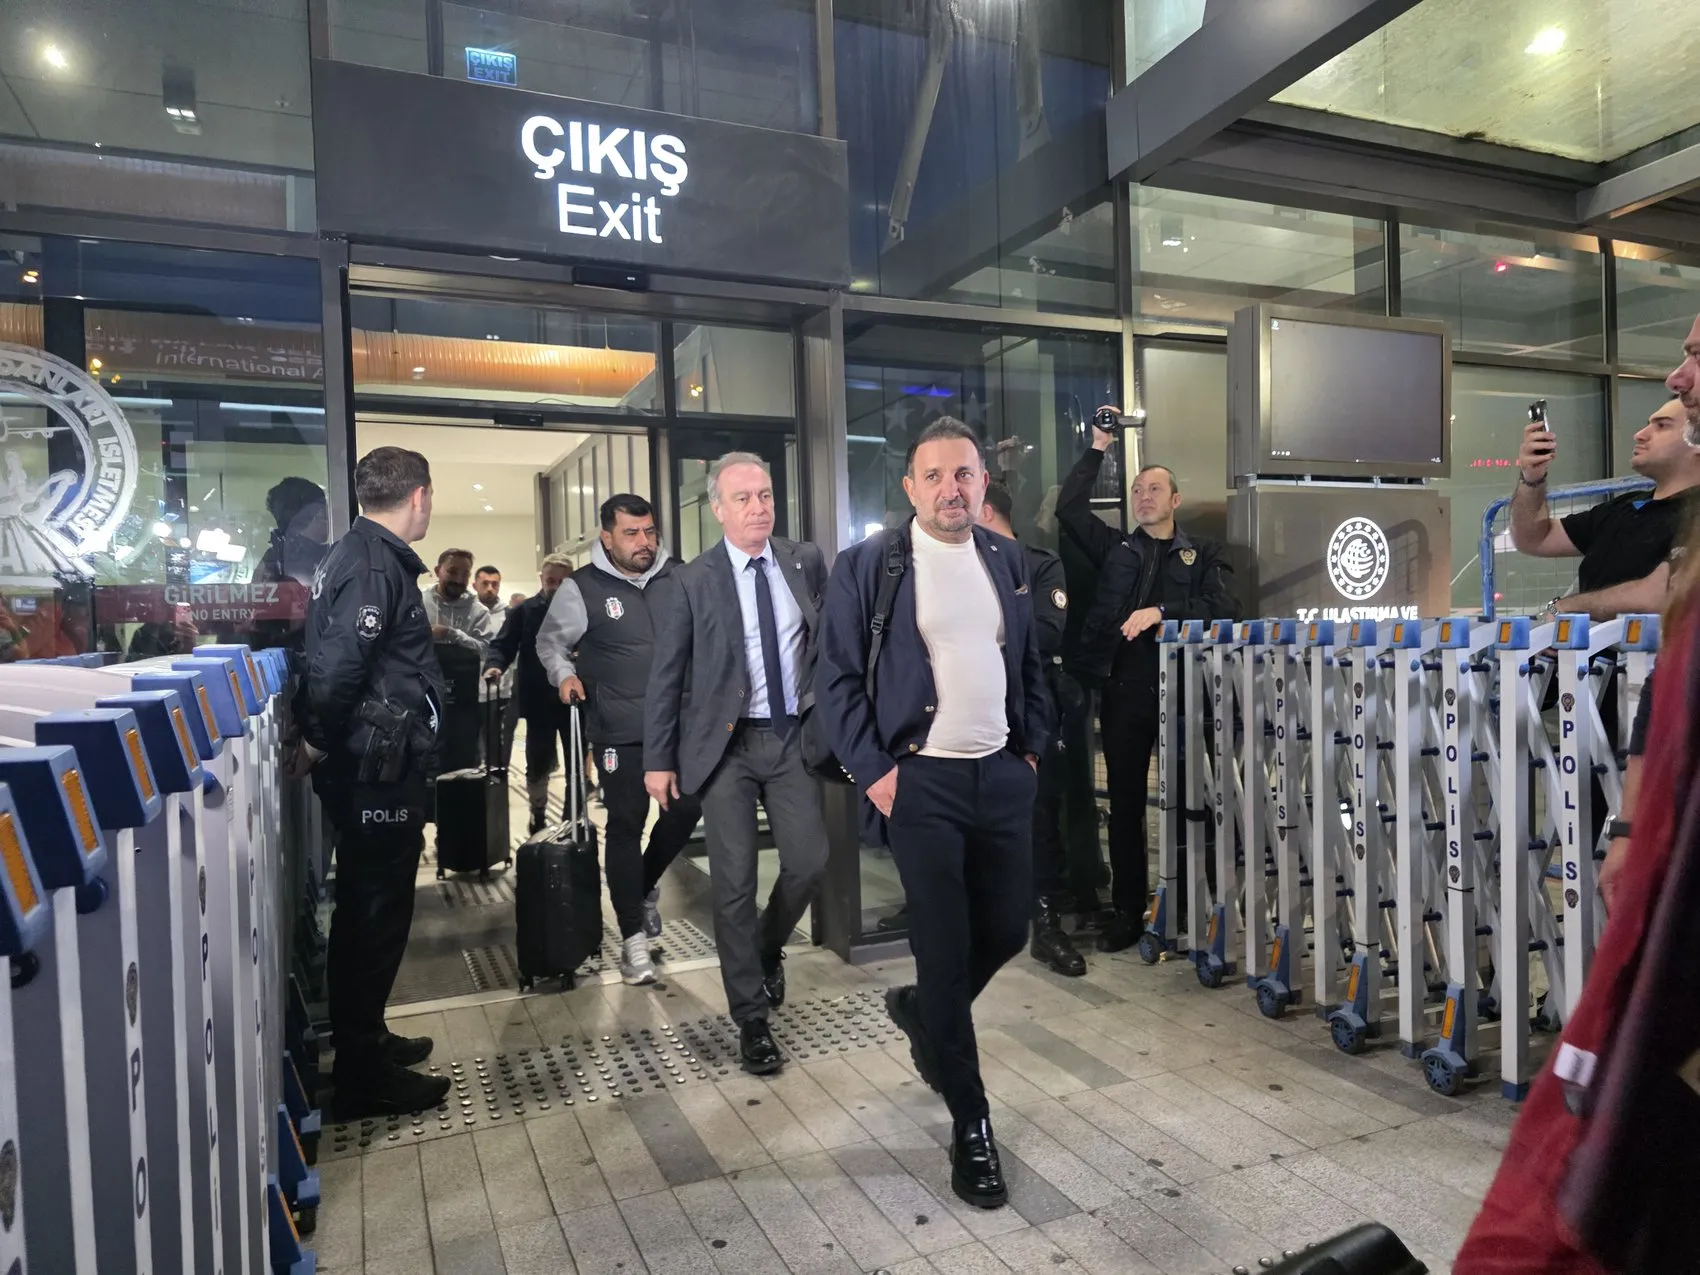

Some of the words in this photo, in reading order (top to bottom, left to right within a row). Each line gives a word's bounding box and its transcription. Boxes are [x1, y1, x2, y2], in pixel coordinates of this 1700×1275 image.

[469, 52, 512, 71] ÇIKIŞ
[474, 67, 511, 83] EXIT
[521, 115, 688, 196] ÇIKIŞ
[557, 182, 663, 243] Exit
[155, 351, 306, 377] International
[191, 608, 208, 621] NO
[213, 607, 256, 621] ENTRY
[1276, 698, 1287, 820] POLİS
[1354, 705, 1365, 838] POLİS
[1446, 712, 1459, 858] POLİS
[1562, 720, 1577, 881] POLİS
[202, 932, 222, 1275] POLİ
